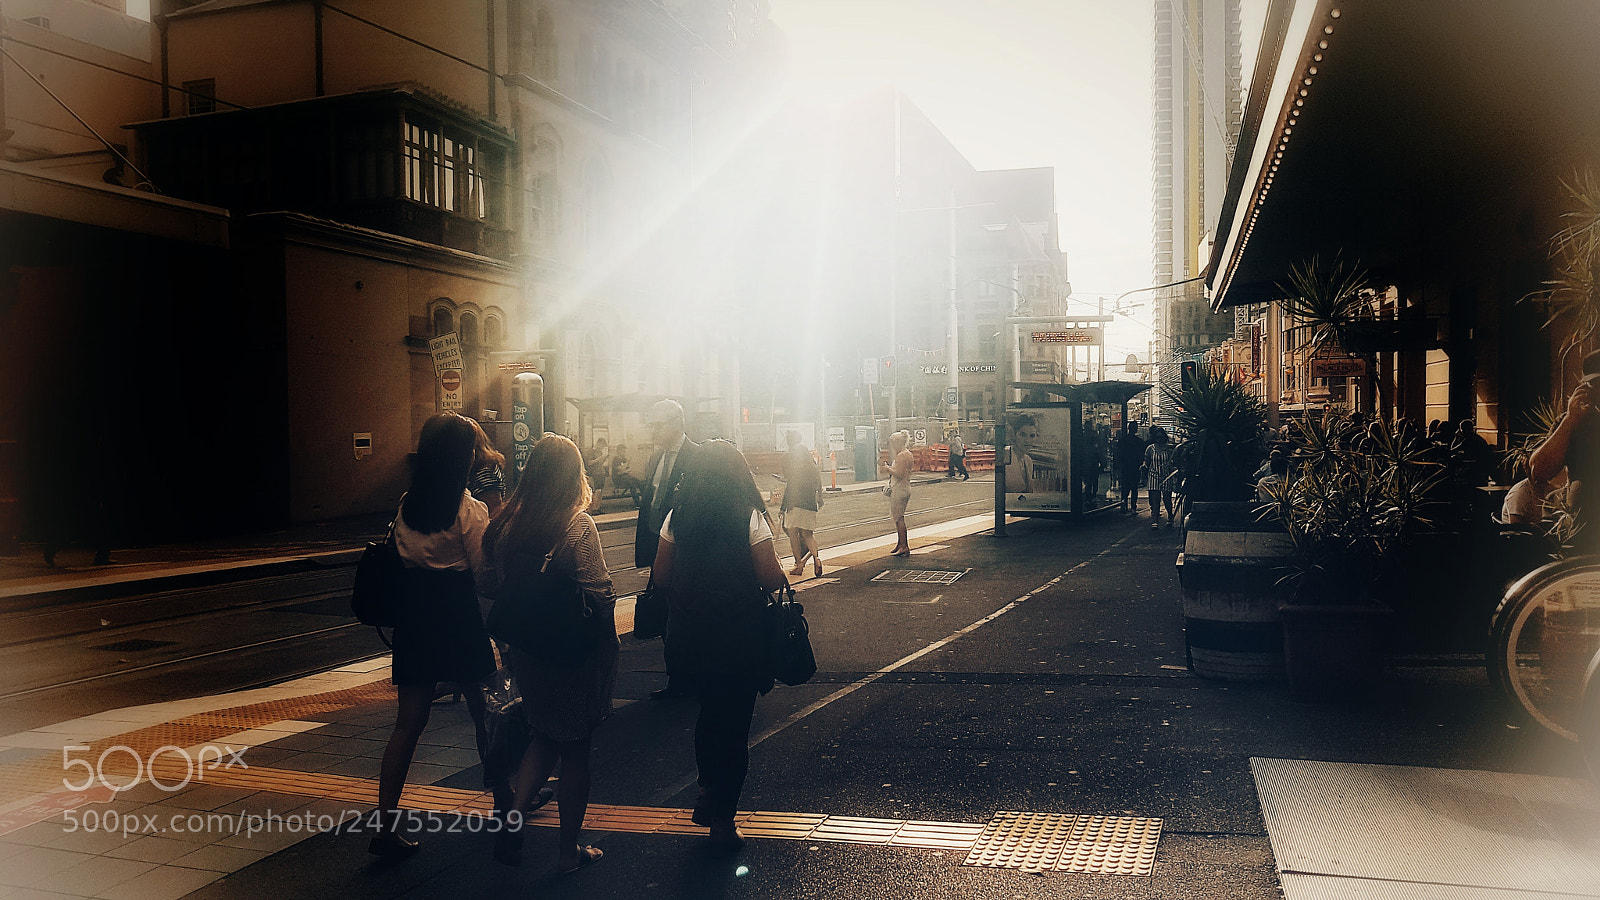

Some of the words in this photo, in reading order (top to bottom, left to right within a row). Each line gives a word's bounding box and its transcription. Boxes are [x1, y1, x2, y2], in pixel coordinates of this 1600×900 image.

[435, 348, 458, 361] VEHICLES
[446, 392, 458, 400] NO
[513, 405, 528, 414] Tap
[514, 443, 529, 452] Tap
[515, 451, 527, 460] off
